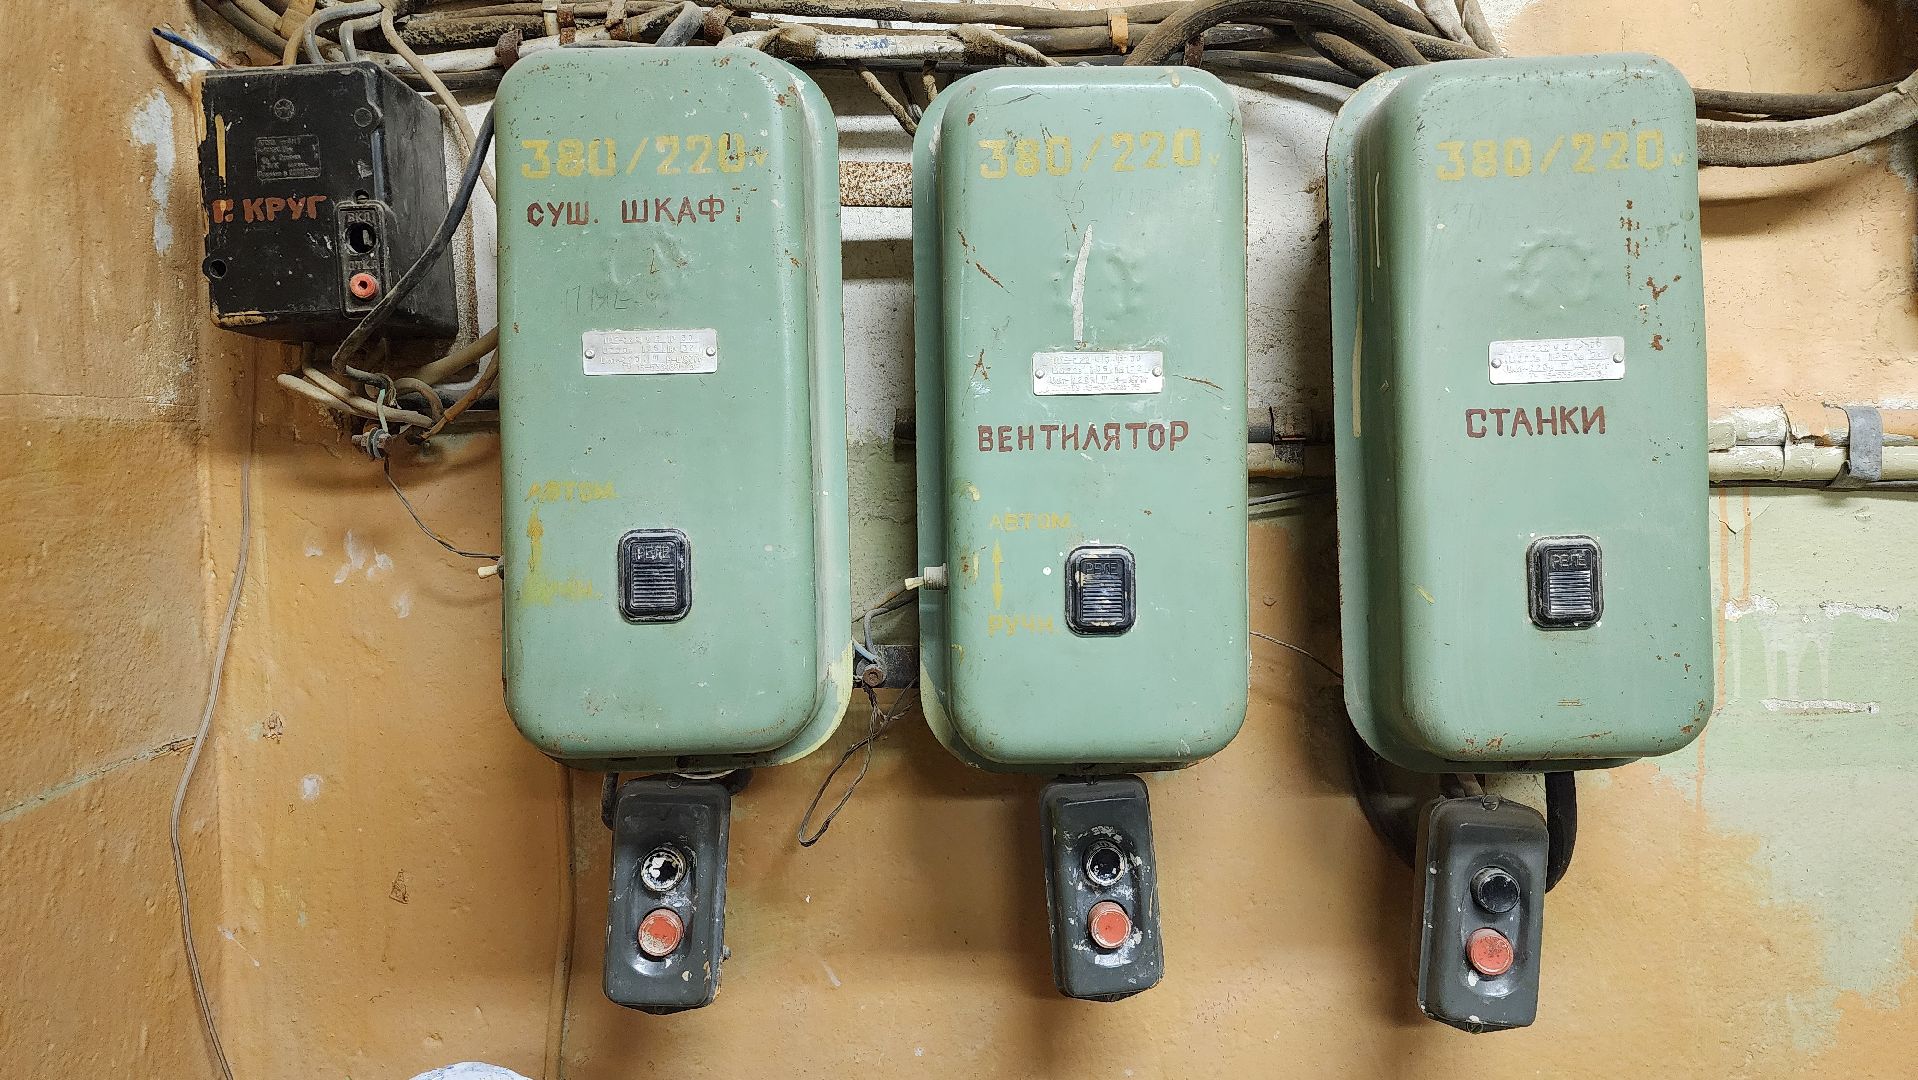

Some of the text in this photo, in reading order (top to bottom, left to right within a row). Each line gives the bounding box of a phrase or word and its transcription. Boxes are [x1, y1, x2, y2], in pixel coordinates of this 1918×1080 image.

[243, 195, 327, 223] КРУГ
[527, 201, 599, 227] СУШ.
[977, 420, 1190, 452] ВЕНТИЛЯТОР
[1465, 405, 1606, 438] СТАНКИ
